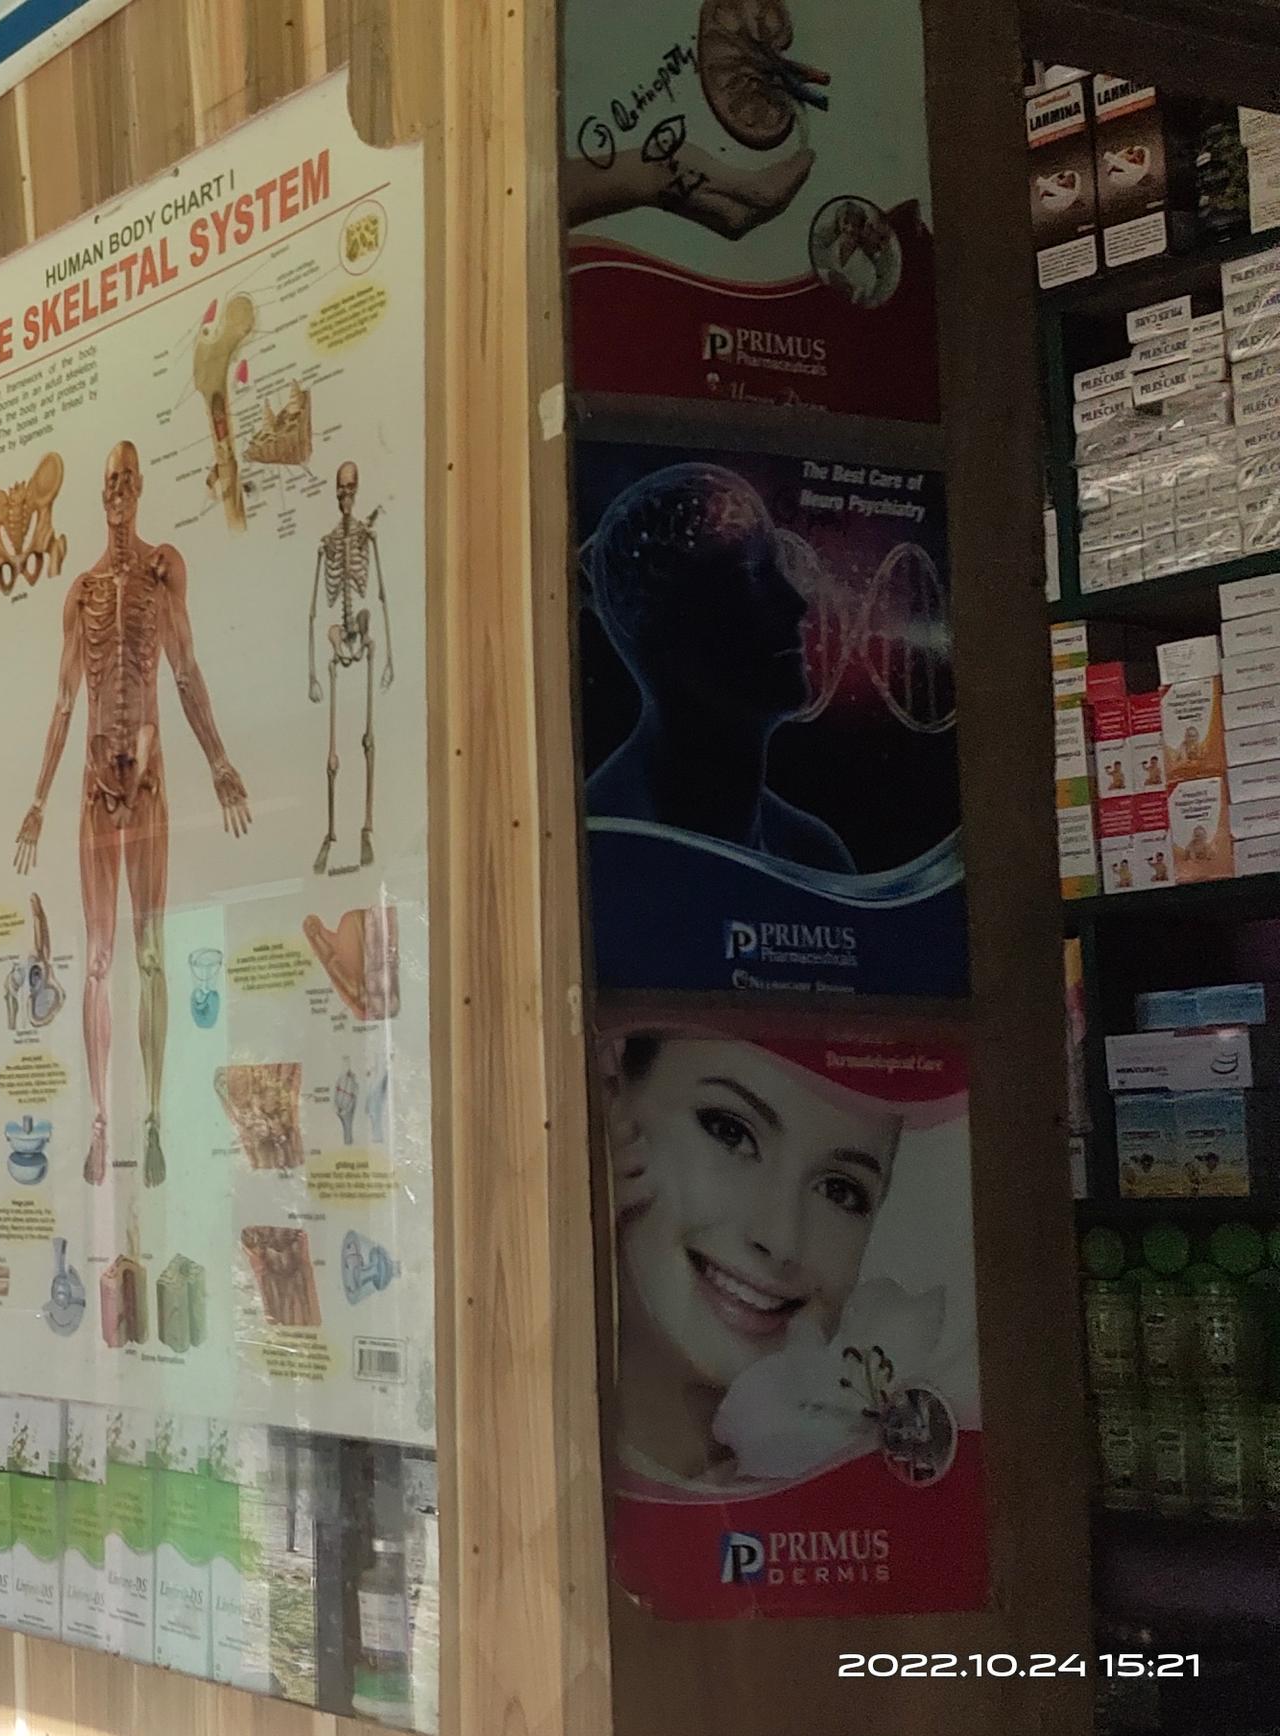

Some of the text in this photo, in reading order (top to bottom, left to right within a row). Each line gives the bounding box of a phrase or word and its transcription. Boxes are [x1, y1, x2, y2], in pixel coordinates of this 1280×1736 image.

[23, 250, 179, 352] SKELETAL
[189, 149, 331, 268] SYSTEM
[45, 242, 104, 289] HUMAN
[109, 216, 156, 261] BODY
[161, 183, 225, 235] CHART
[736, 327, 826, 361] PRIMUS
[760, 922, 857, 950] PRIMUS
[768, 1529, 890, 1563] PRIMUS
[768, 1564, 890, 1585] DERMIS
